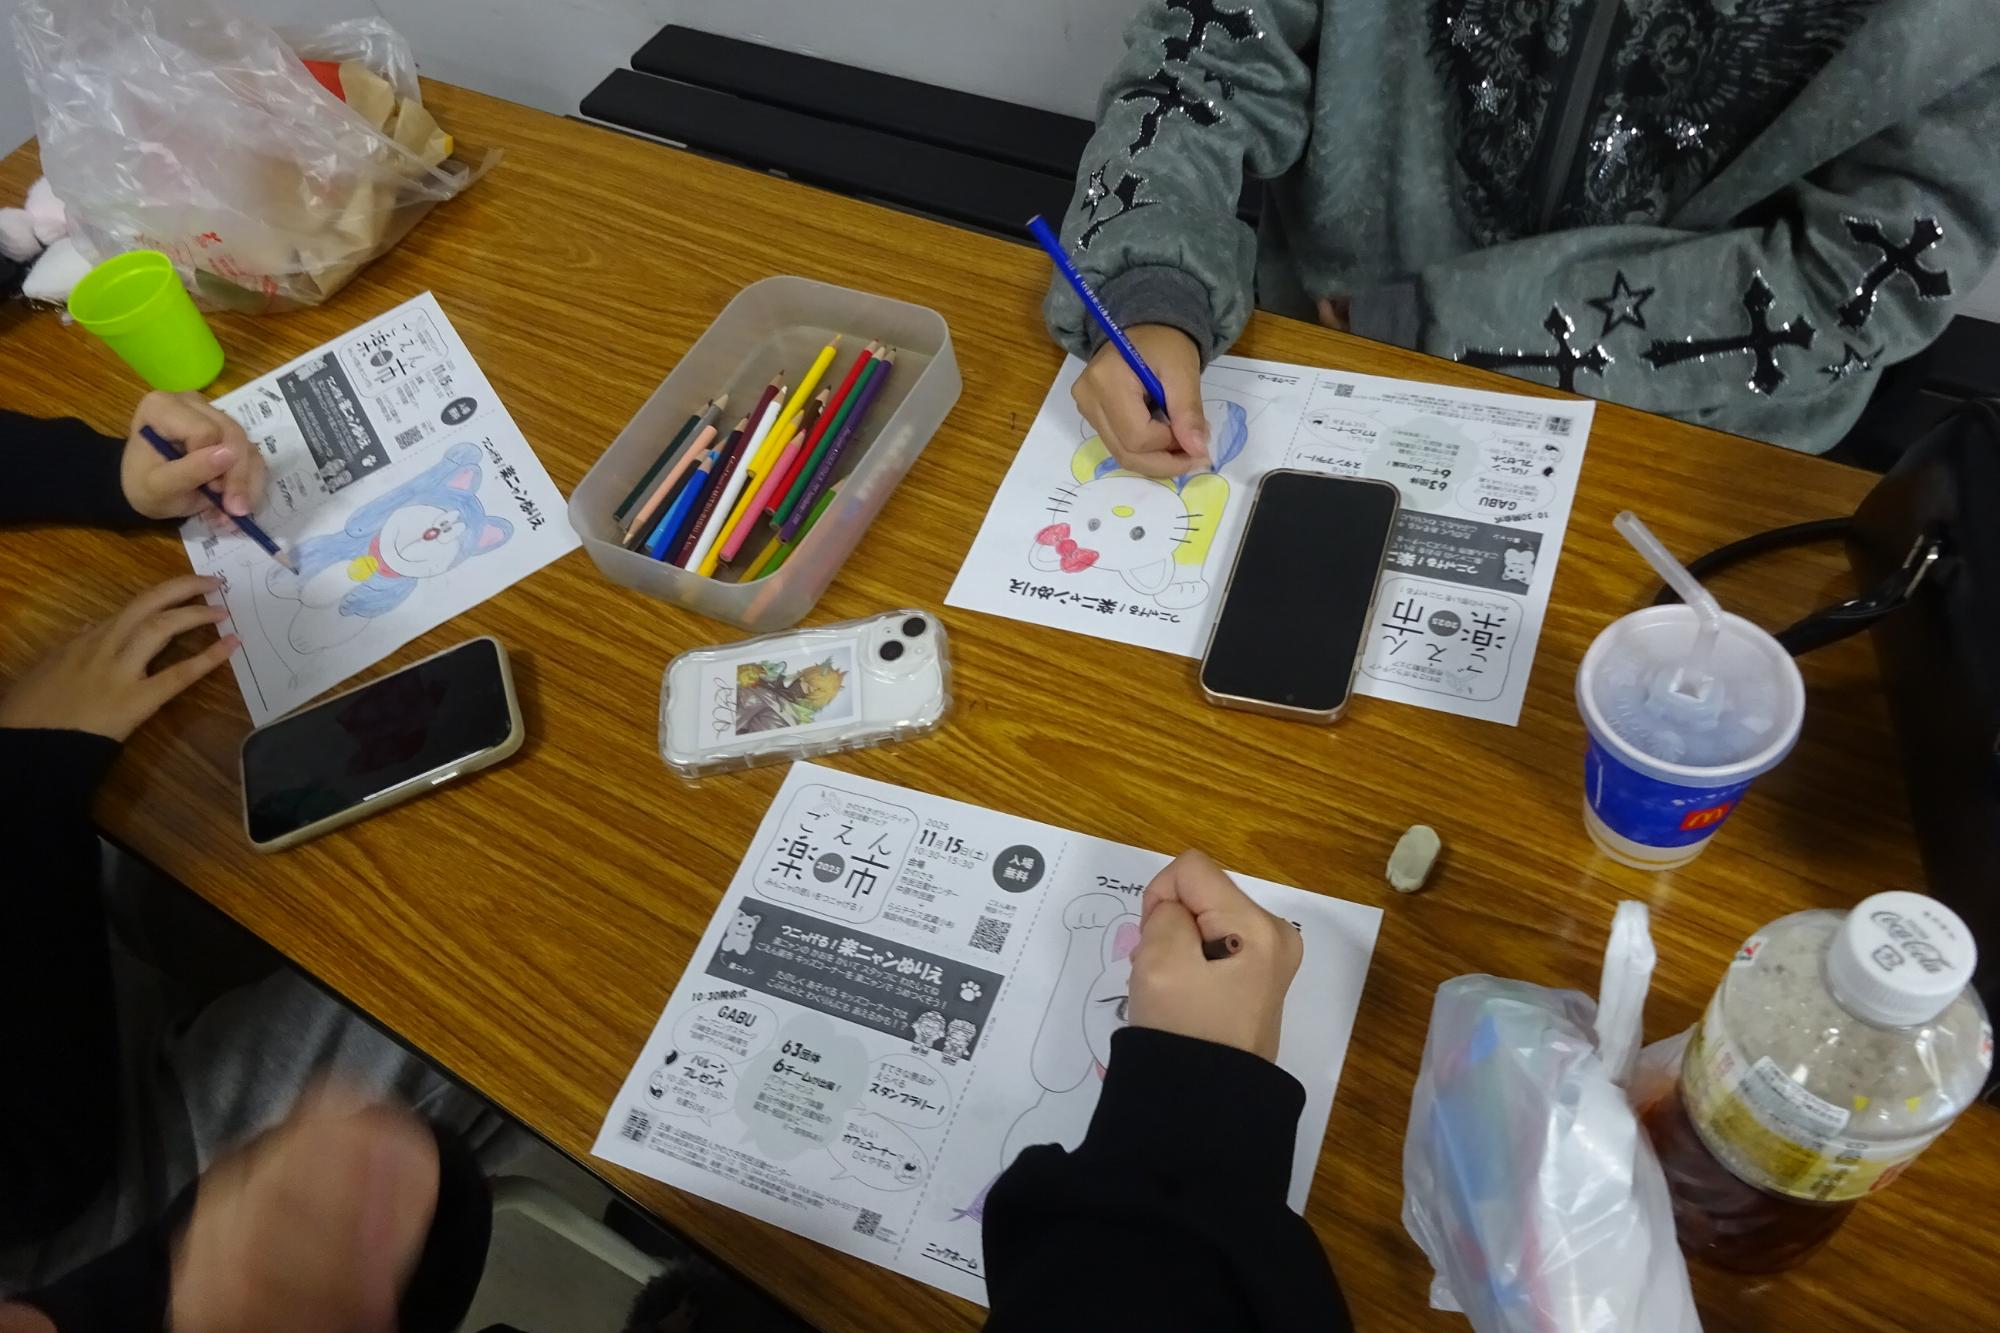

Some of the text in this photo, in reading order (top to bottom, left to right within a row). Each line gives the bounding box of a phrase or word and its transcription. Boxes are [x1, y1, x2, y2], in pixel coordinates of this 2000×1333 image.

[1477, 496, 1517, 510] GABU
[1380, 597, 1506, 652] 楽 2025 市
[1382, 634, 1487, 674] ごえん
[799, 810, 891, 856] ごえん
[924, 818, 950, 831] 2025
[770, 834, 889, 898] 楽 2025 市
[906, 857, 926, 869] 会場
[1008, 853, 1034, 870] 入場
[1002, 866, 1029, 882] 無料
[1870, 910, 1956, 974] Coca-Cola
[727, 961, 754, 975] 楽ニャン
[716, 1004, 758, 1028] GABU
[779, 1038, 824, 1064] 63団体
[689, 1054, 728, 1074] バルーン
[682, 1065, 724, 1088] プレゼント
